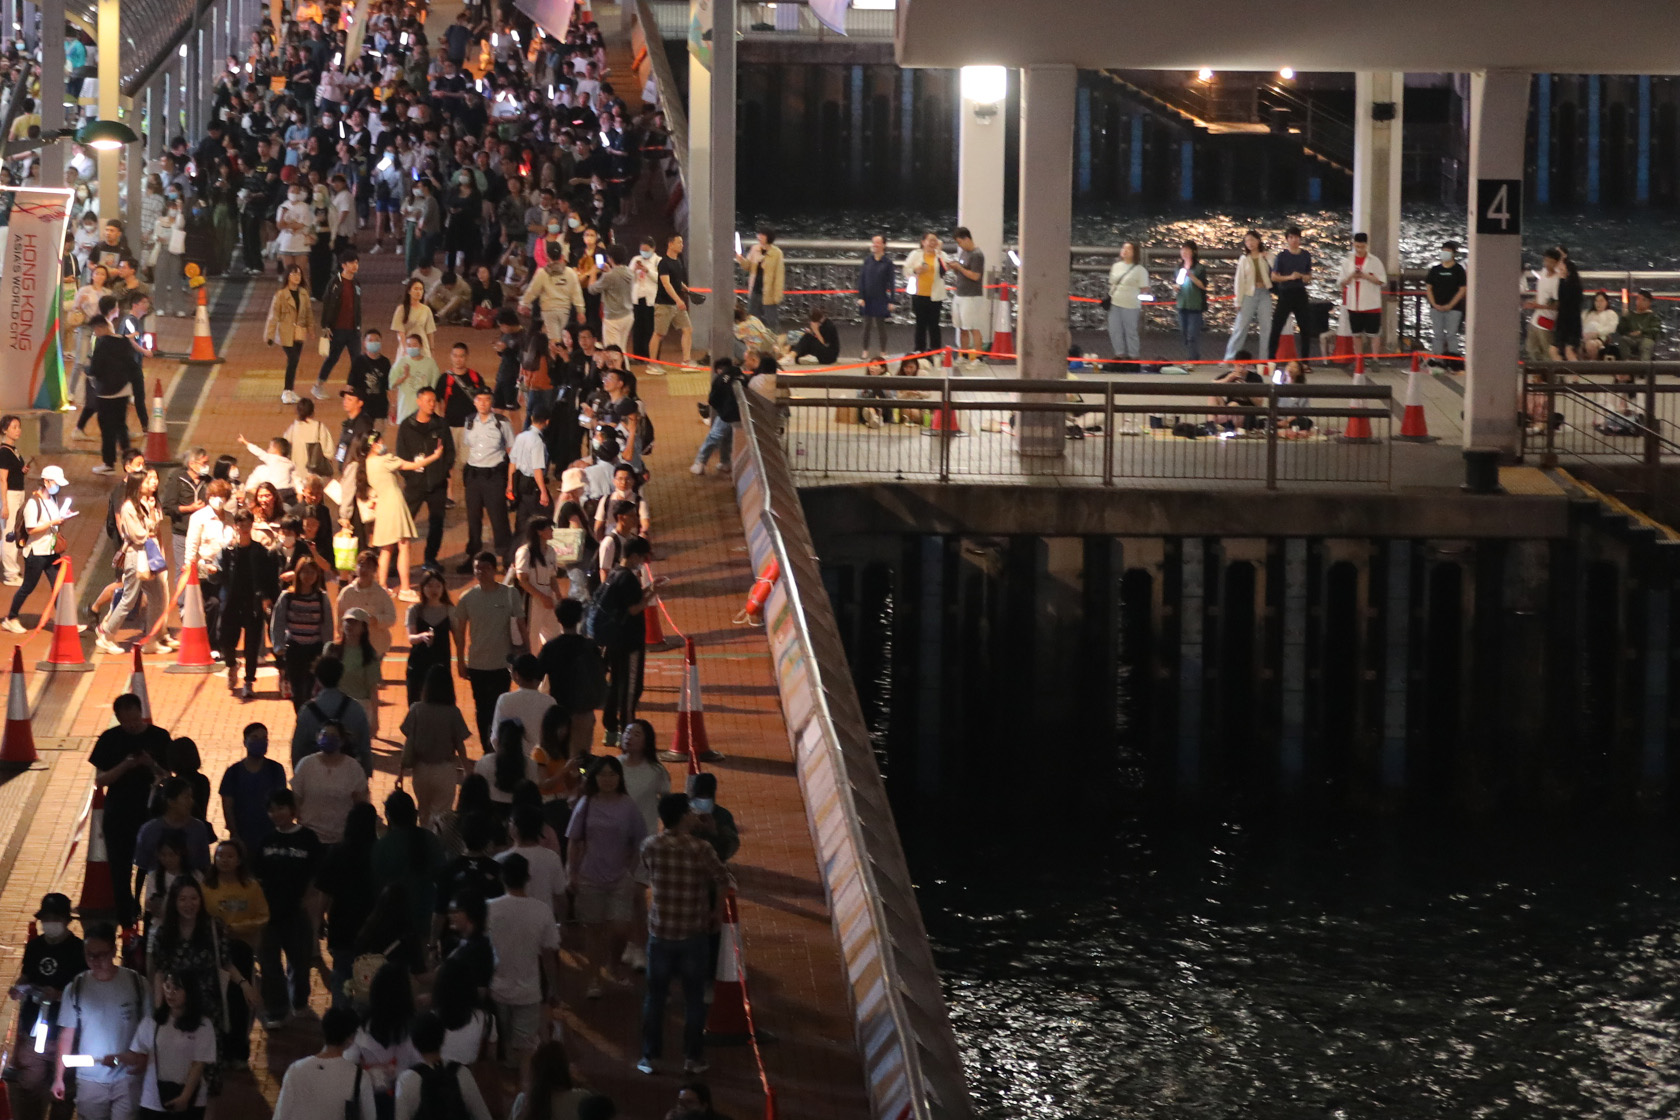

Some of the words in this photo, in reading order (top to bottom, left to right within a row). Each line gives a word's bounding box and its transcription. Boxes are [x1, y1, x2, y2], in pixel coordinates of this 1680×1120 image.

[1486, 183, 1511, 230] 4
[12, 234, 22, 273] ASIA'S
[22, 234, 37, 291] HONG
[11, 276, 22, 320] WORLD
[9, 321, 19, 350] CITY
[19, 295, 35, 351] KONG
